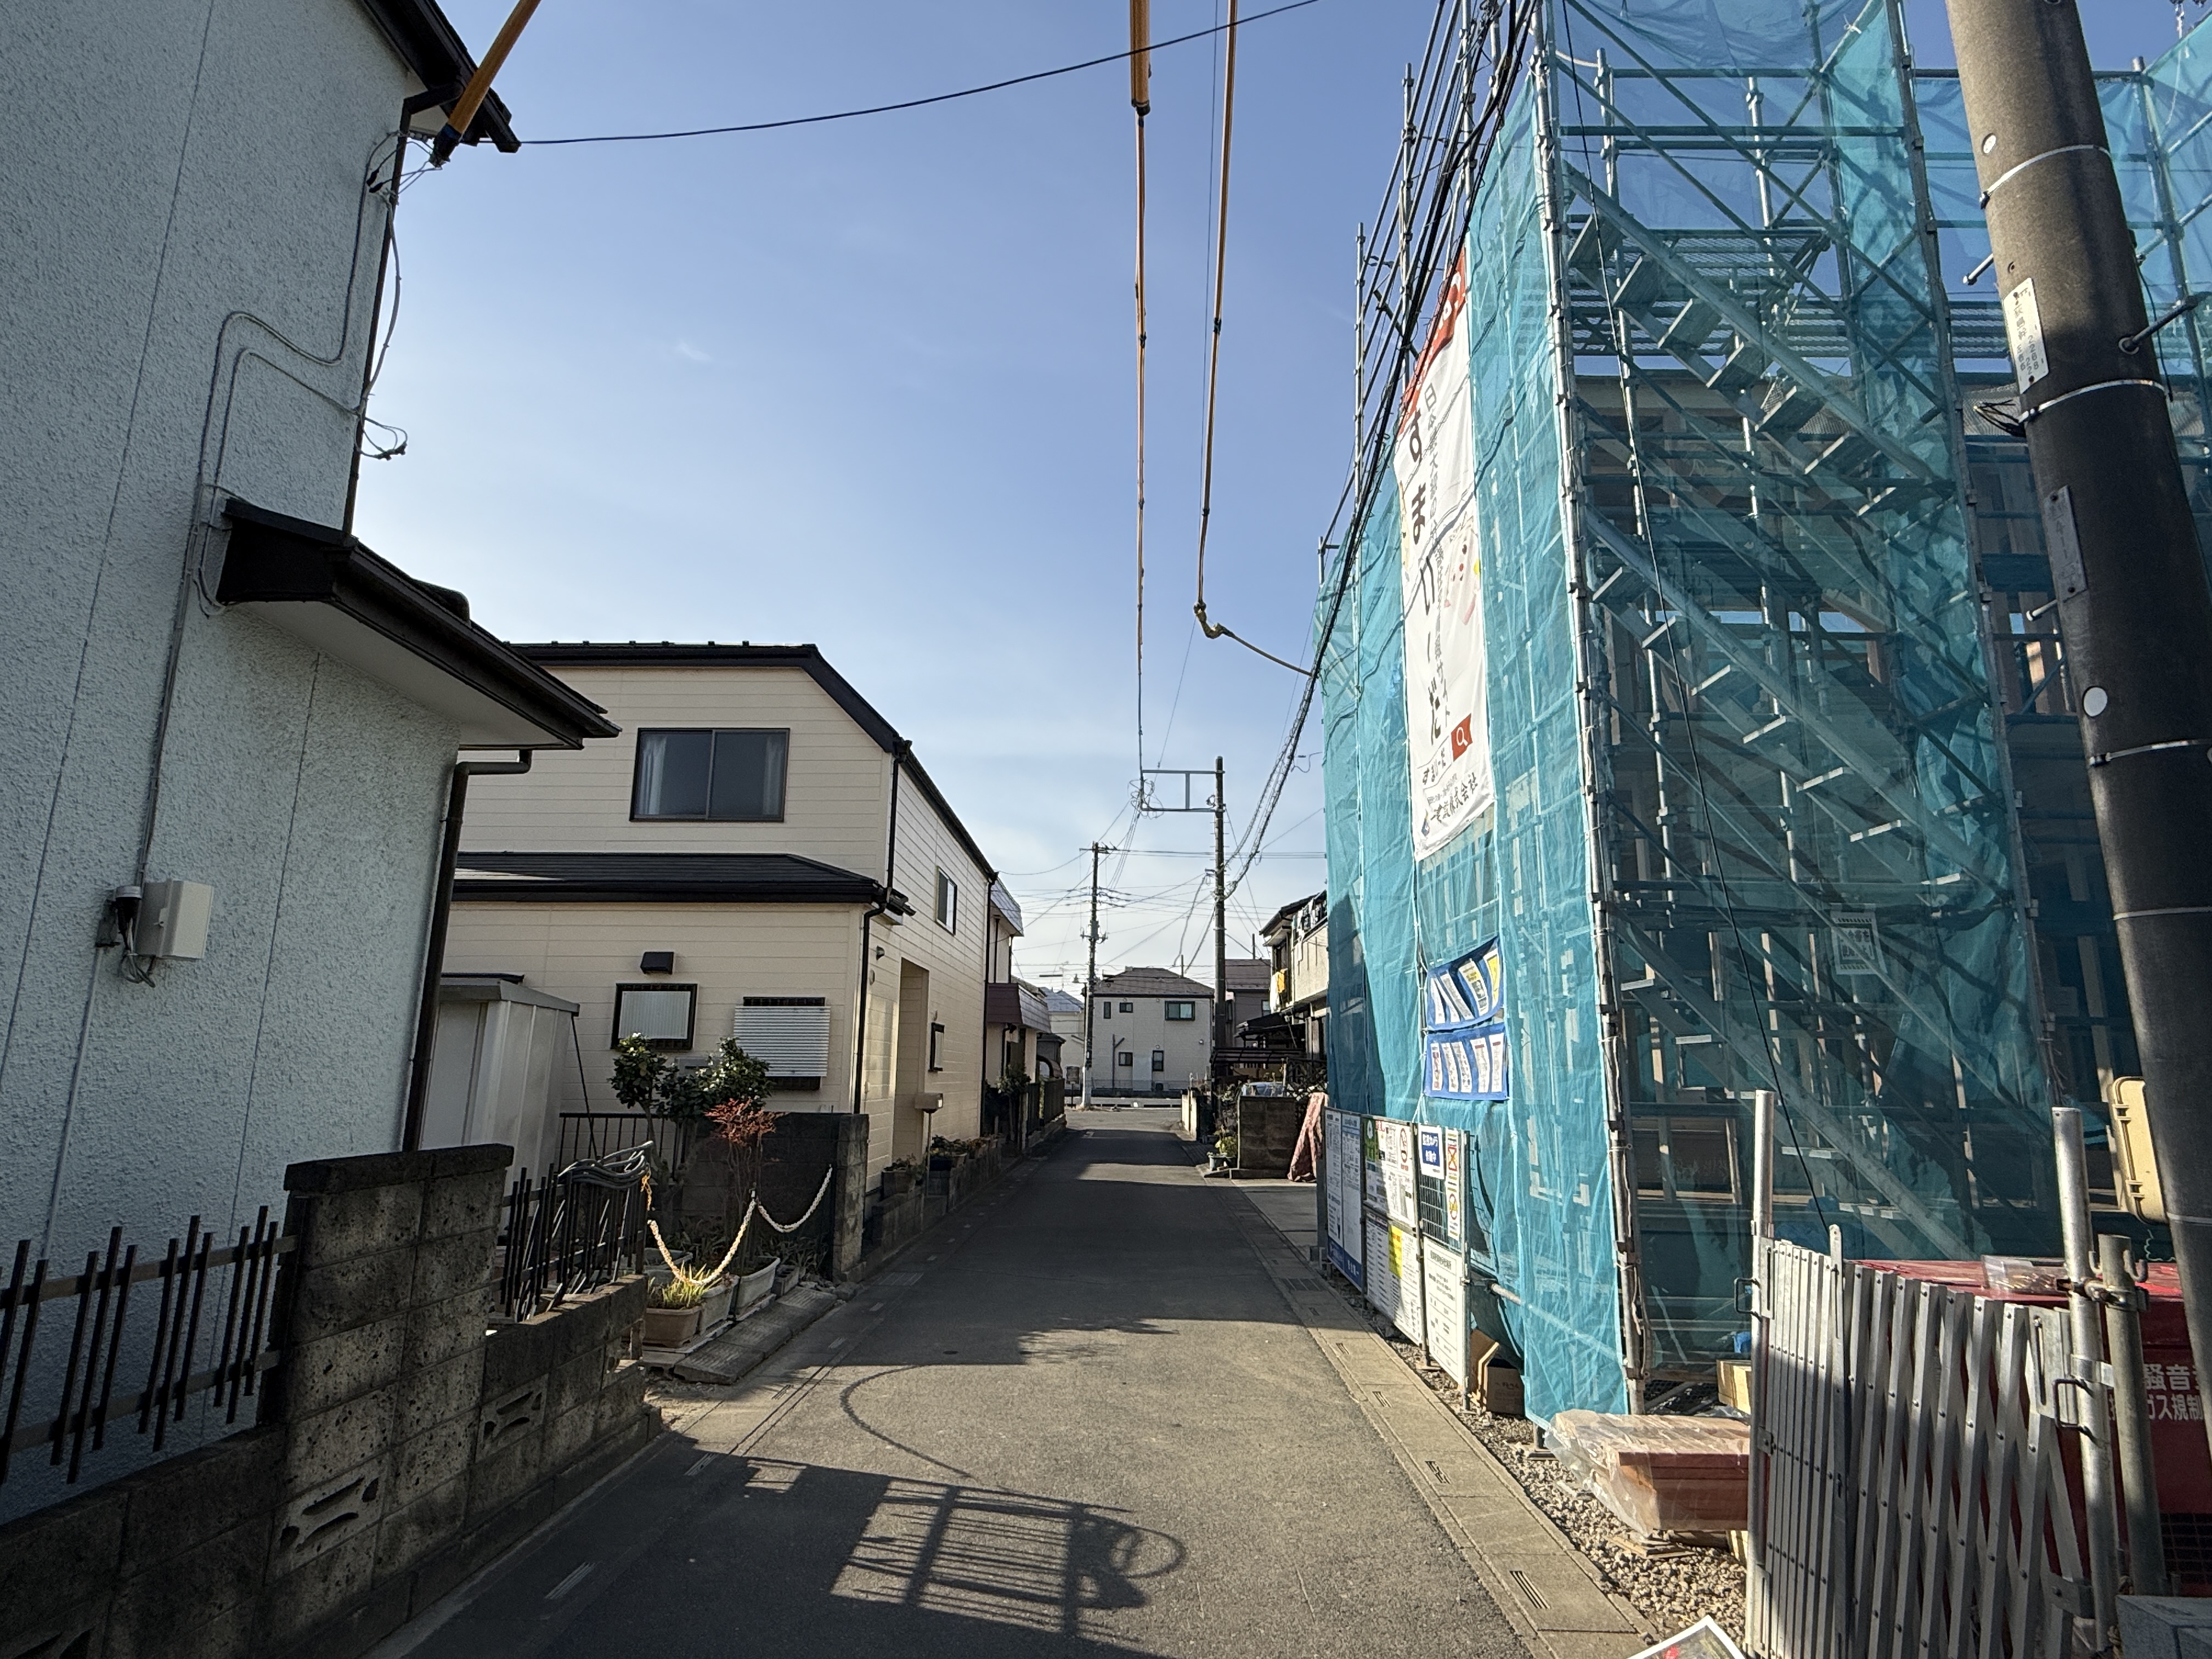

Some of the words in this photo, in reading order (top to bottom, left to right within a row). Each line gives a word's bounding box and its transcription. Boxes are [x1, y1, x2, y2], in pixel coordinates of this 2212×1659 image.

[1409, 409, 1441, 746] すまいーだ
[1423, 747, 1446, 785] すまいーだ
[2143, 1364, 2200, 1391] 騒音
